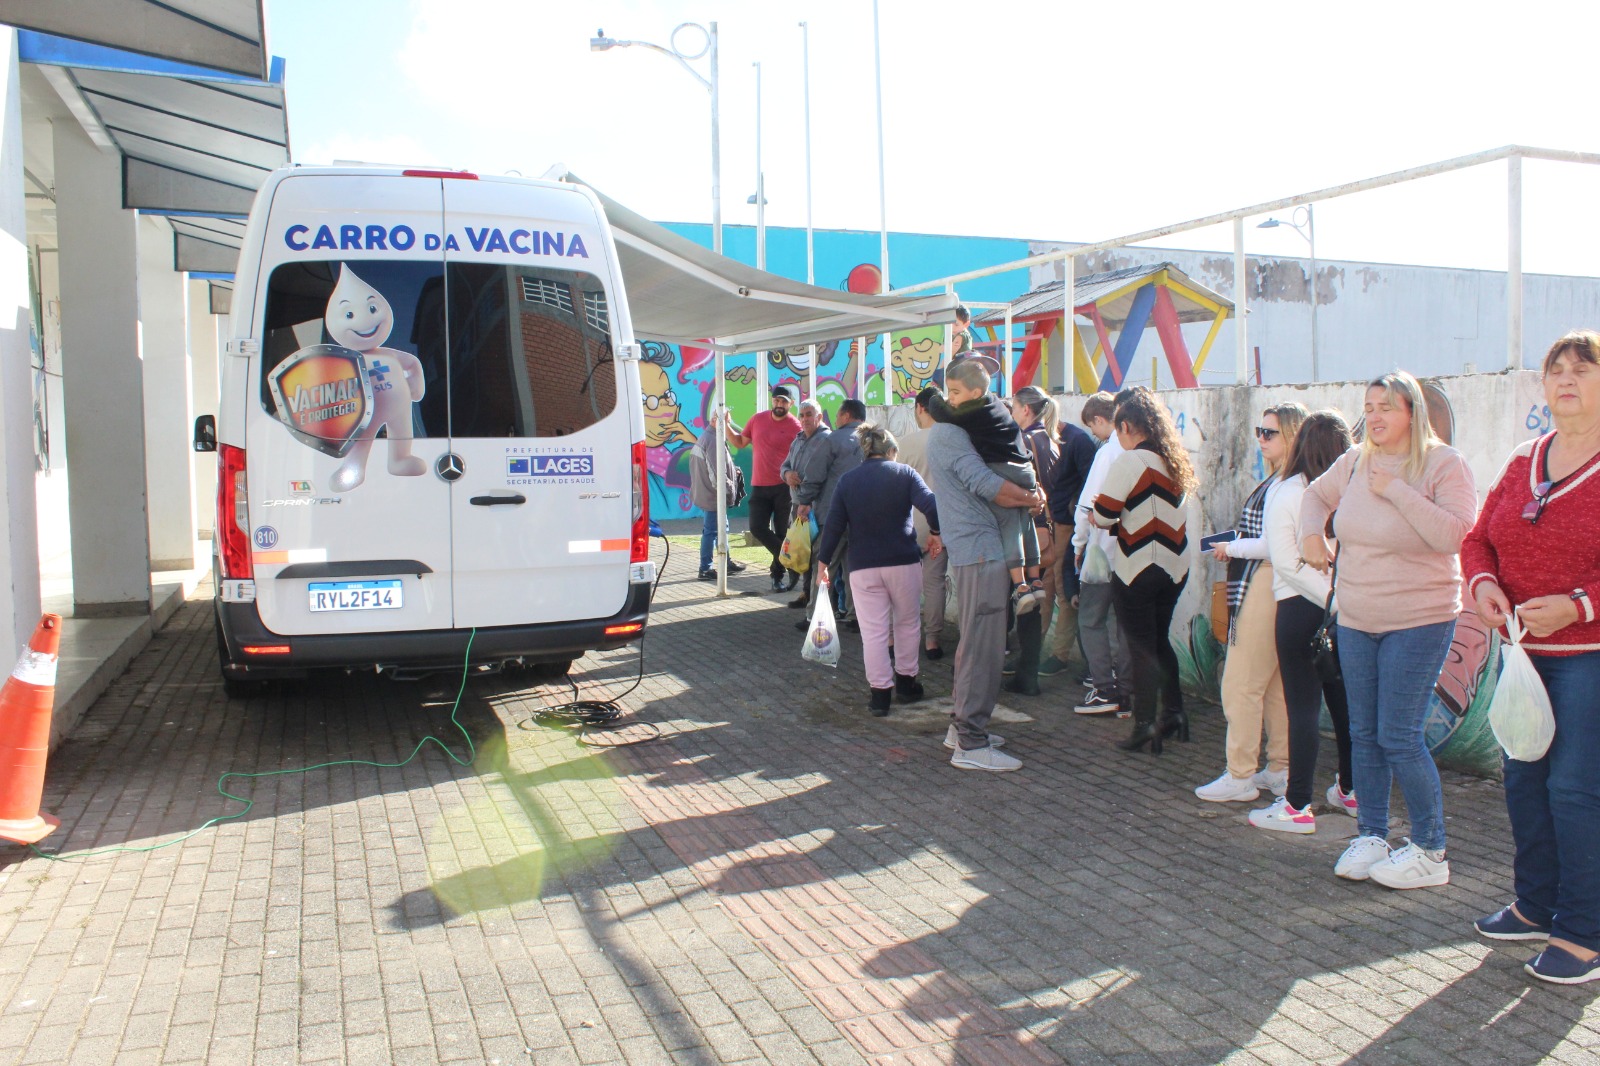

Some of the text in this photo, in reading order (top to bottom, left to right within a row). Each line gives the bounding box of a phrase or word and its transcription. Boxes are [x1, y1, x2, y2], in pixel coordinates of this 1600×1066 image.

[284, 224, 590, 259] CARRO DA VACINA
[288, 377, 359, 413] VACINAR
[374, 381, 393, 393] SUS
[308, 401, 357, 424] PROTEGER
[533, 458, 591, 474] LAGES
[290, 481, 311, 491] TCA
[257, 530, 275, 544] 810
[317, 590, 393, 609] RYL2F14
